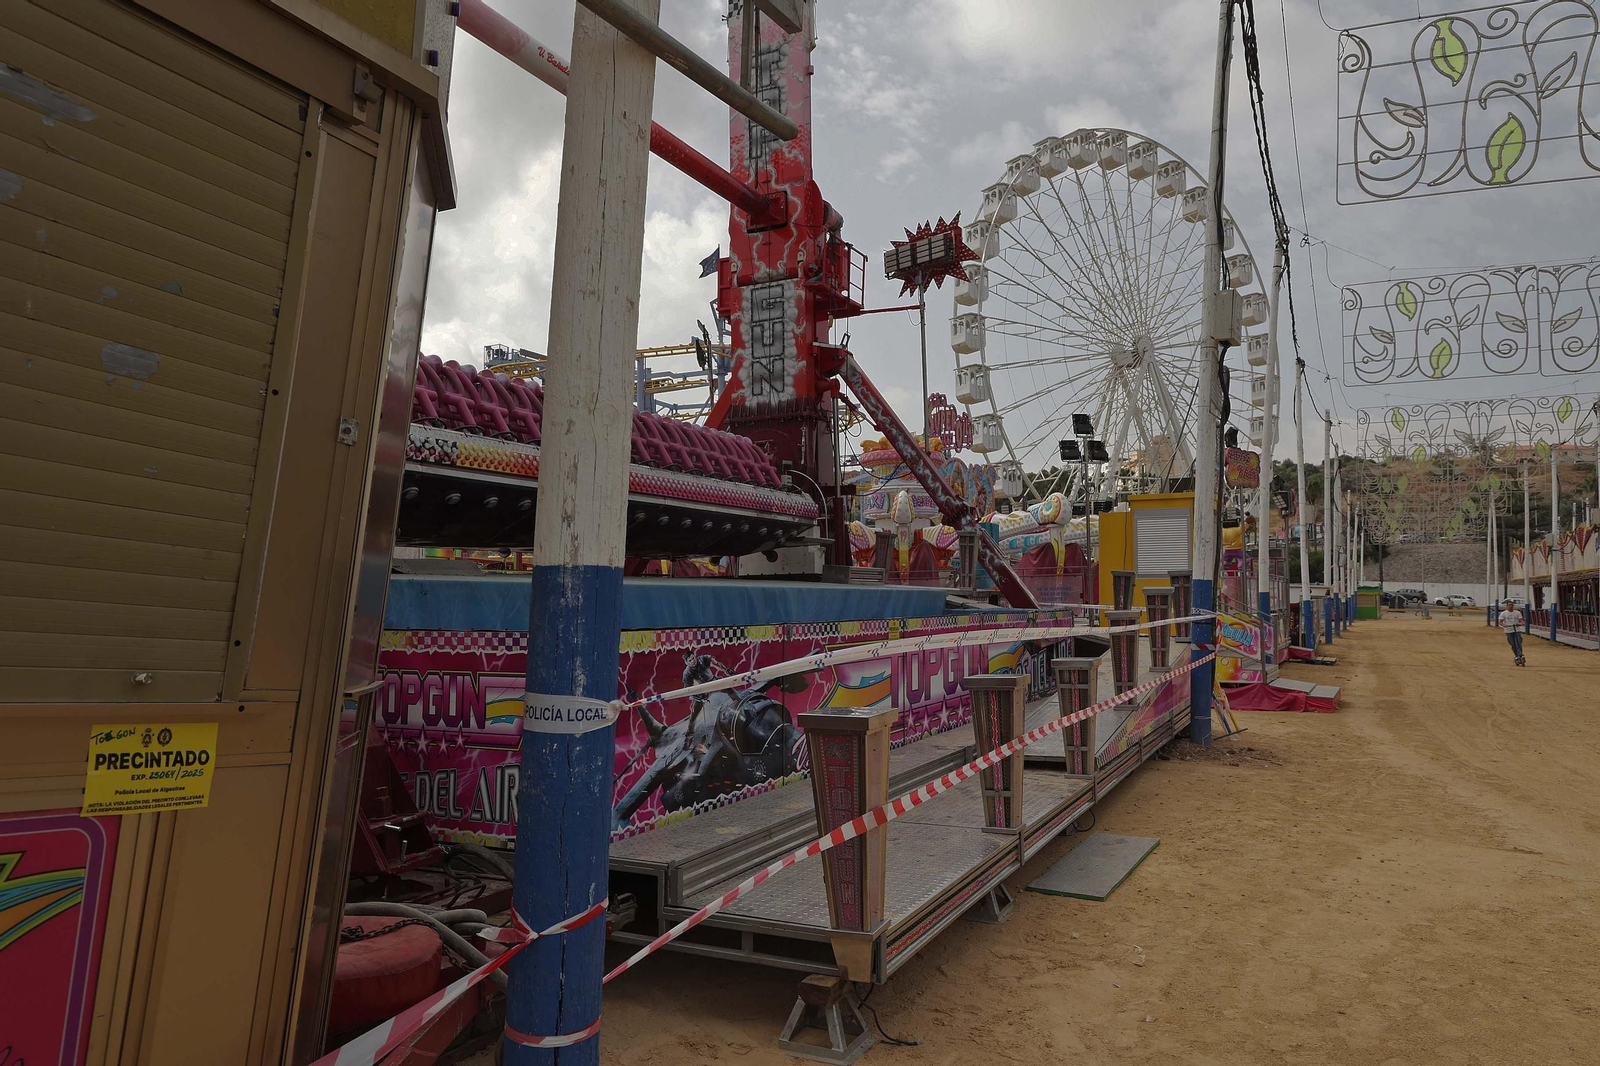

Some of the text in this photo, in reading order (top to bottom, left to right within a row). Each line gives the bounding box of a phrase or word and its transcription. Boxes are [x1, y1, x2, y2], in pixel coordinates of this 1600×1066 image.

[525, 705, 607, 722] POLICÍA LOCAL
[94, 750, 210, 770] PRECINTADO
[415, 763, 521, 825] DEL AIR
